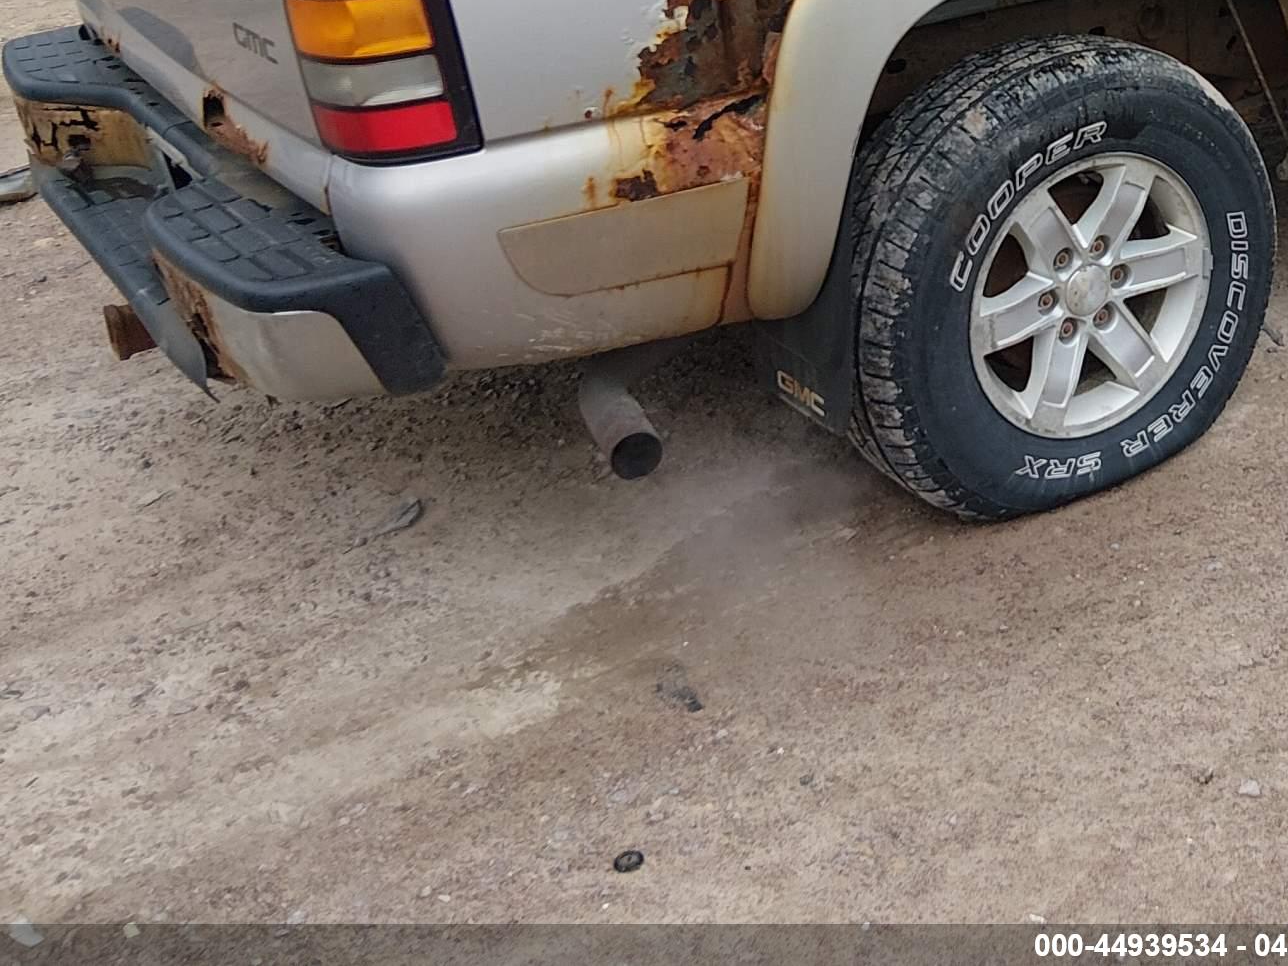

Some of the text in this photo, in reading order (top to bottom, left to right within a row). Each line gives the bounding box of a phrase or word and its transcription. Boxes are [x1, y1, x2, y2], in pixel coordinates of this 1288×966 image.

[232, 22, 279, 65] GMC
[949, 121, 1107, 293] COOPER
[777, 370, 826, 417] GMC
[1015, 211, 1249, 479] DISCOVERER SRX
